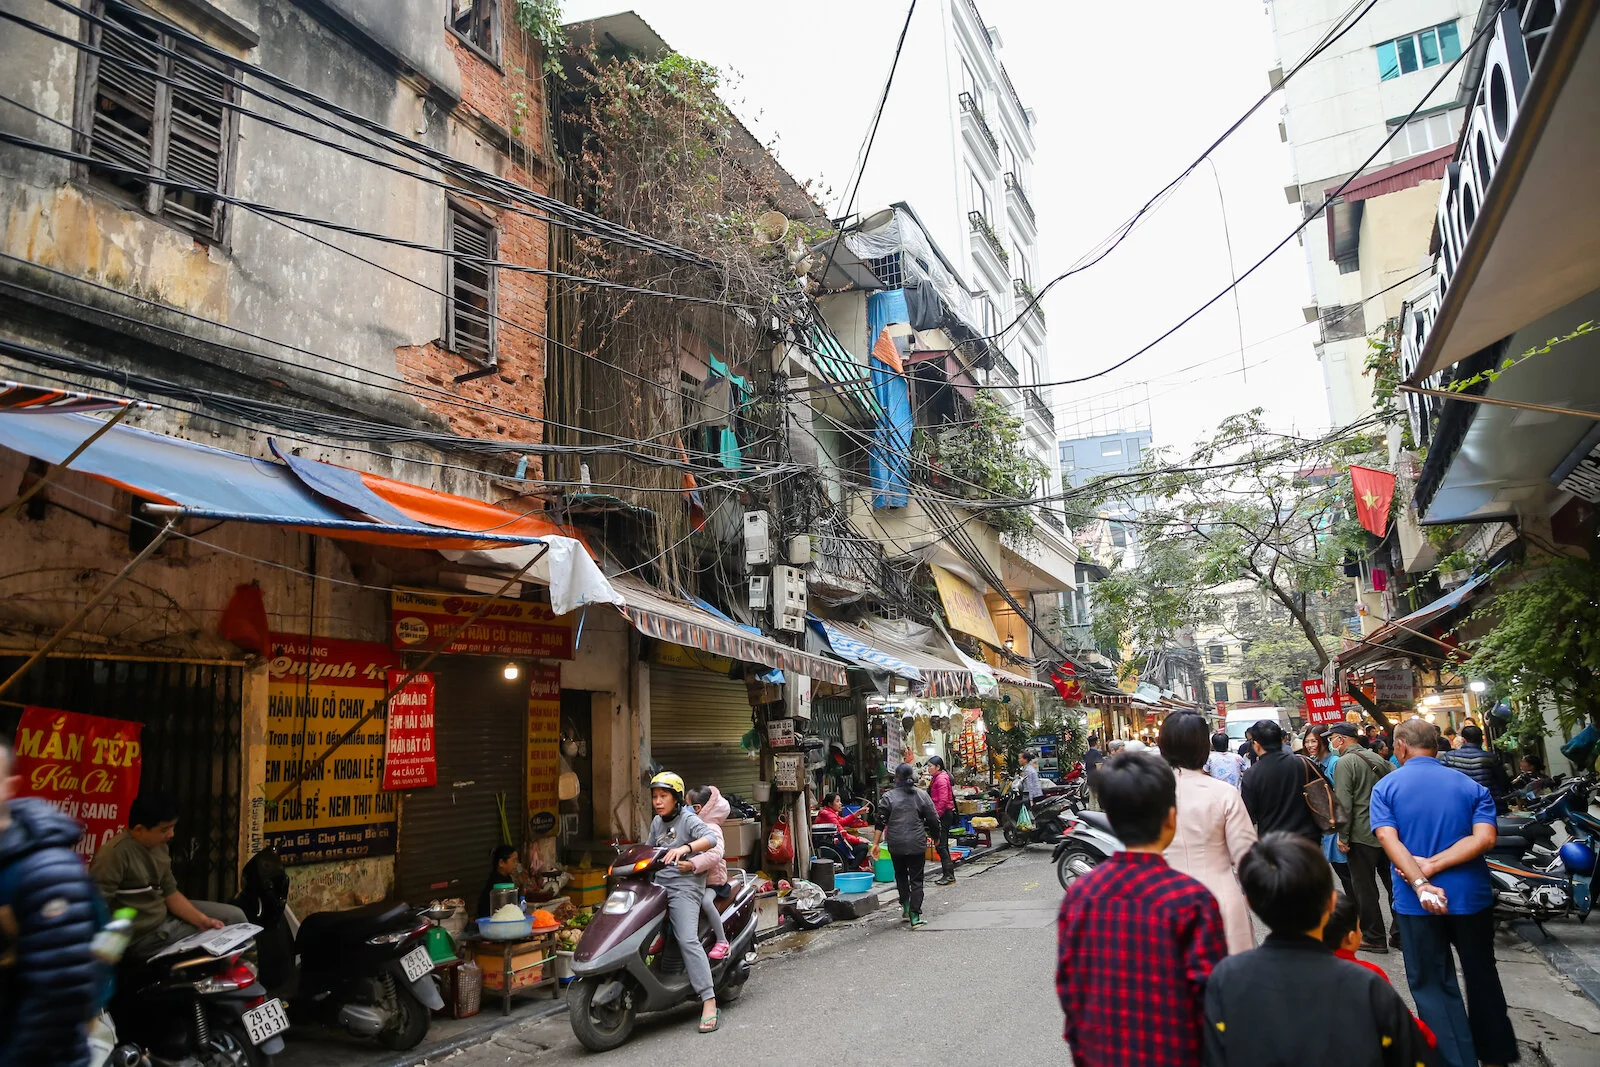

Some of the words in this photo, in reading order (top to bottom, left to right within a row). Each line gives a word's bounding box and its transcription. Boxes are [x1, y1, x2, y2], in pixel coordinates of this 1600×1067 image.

[339, 698, 365, 719] CHAY
[1324, 710, 1342, 722] LONG
[16, 716, 85, 763] MẮM
[269, 730, 288, 749] Trọn
[31, 764, 80, 792] Kim
[81, 769, 118, 795] Chi
[334, 758, 361, 780] KHOAI
[81, 802, 119, 820] SANG
[329, 795, 351, 817] NEM
[404, 950, 425, 968] 29-C1
[249, 1003, 279, 1027] 29-E1
[251, 1015, 288, 1042] 319.31
